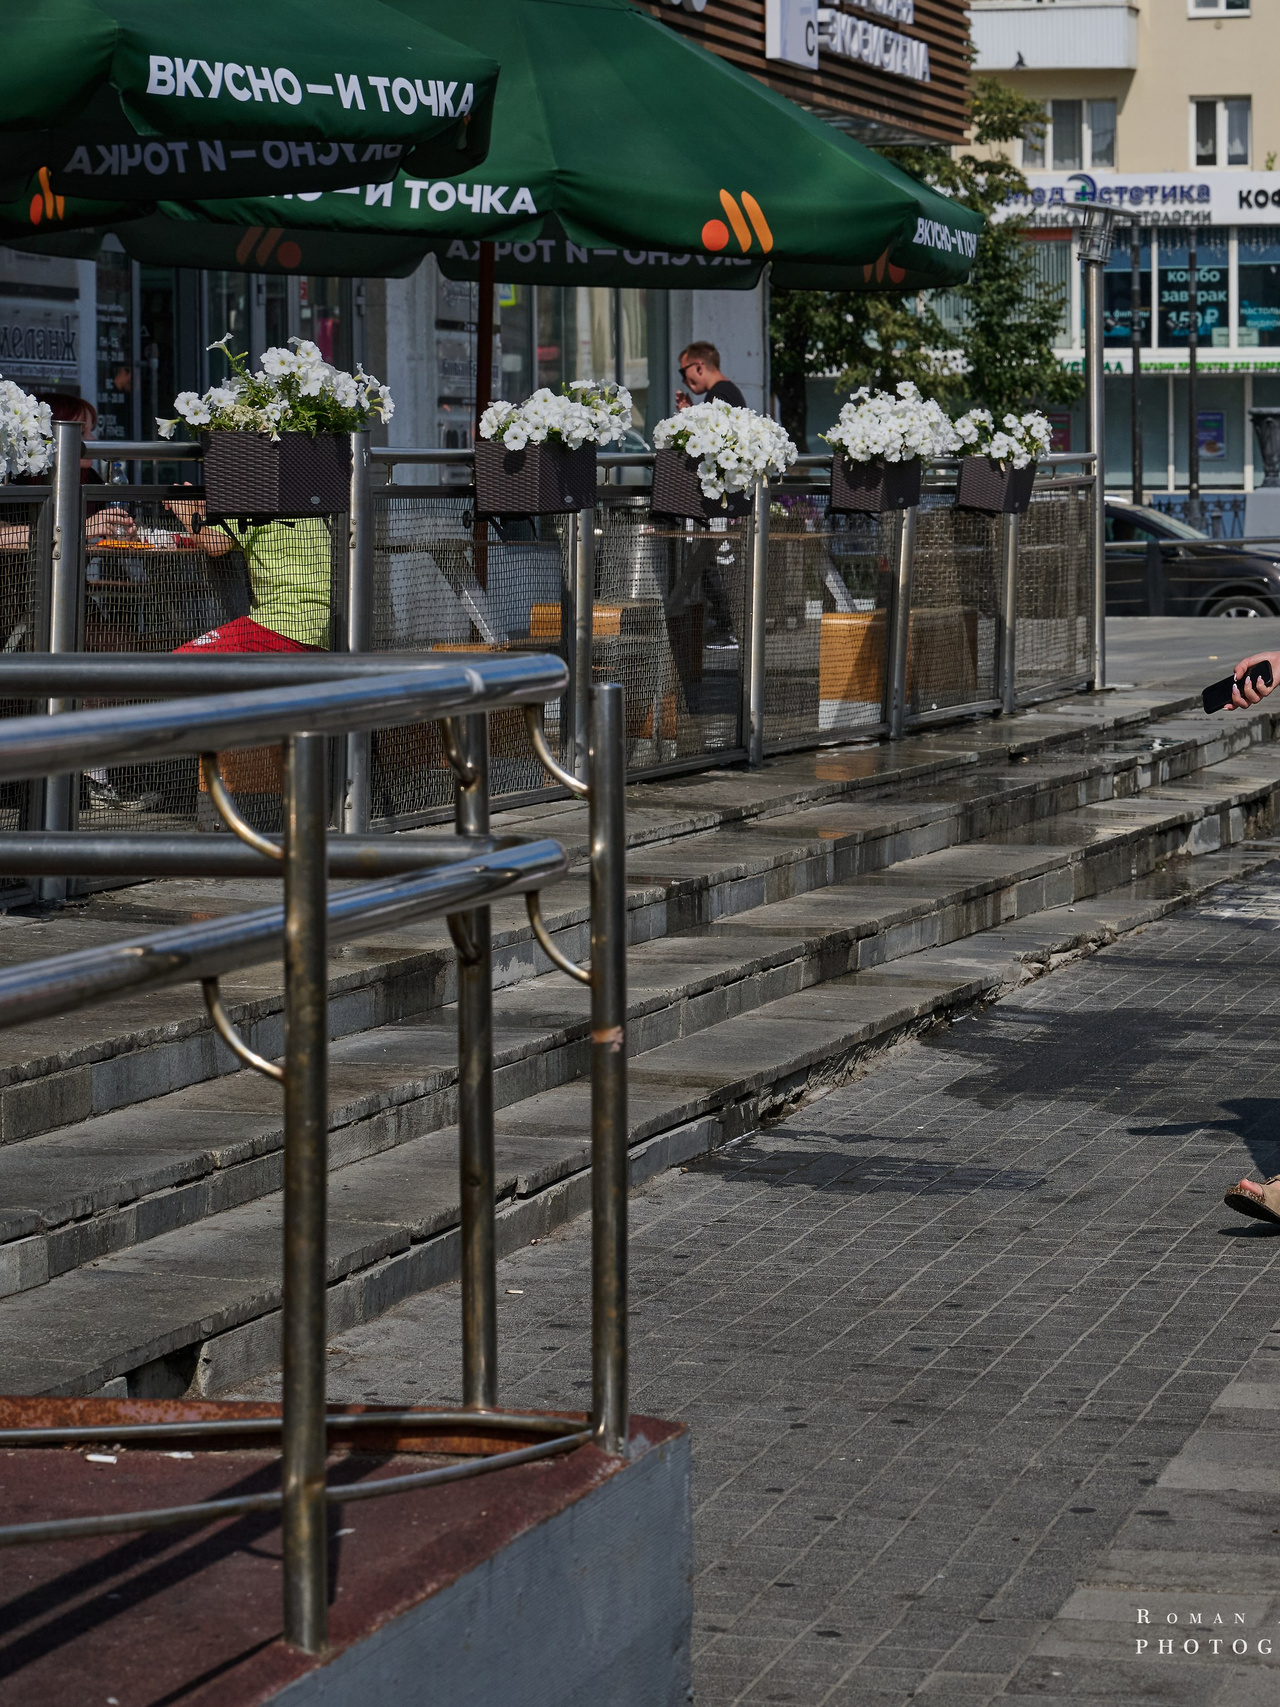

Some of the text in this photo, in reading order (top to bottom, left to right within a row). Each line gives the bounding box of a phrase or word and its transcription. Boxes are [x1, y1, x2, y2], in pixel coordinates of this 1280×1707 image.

[367, 76, 474, 117] ТОЧКА
[404, 179, 537, 215] ТОЧКА
[1161, 290, 1227, 305] заврак
